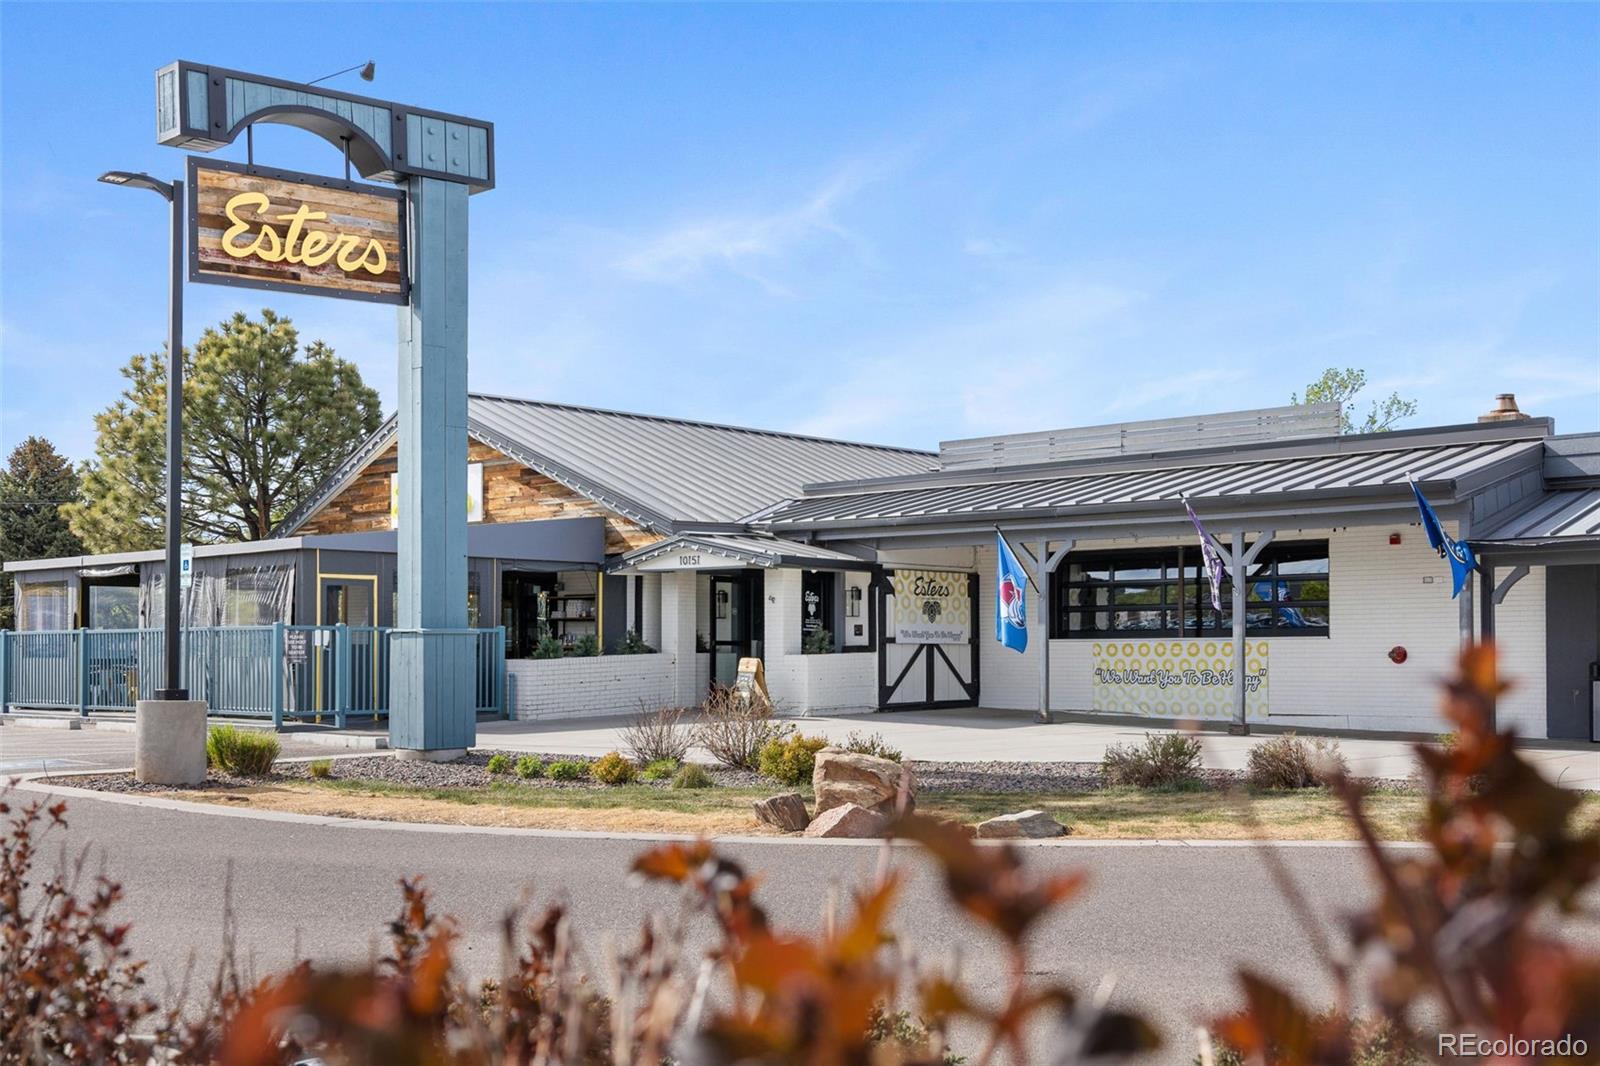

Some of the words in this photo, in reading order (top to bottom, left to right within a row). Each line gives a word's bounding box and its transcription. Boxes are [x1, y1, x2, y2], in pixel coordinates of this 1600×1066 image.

[221, 192, 387, 275] Esters
[680, 555, 700, 566] 10151
[913, 576, 950, 597] Esters
[1123, 668, 1157, 685] Want
[1157, 668, 1183, 689] You
[1182, 668, 1200, 685] To
[1199, 669, 1220, 686] Be
[1219, 668, 1267, 692] Hpy"
